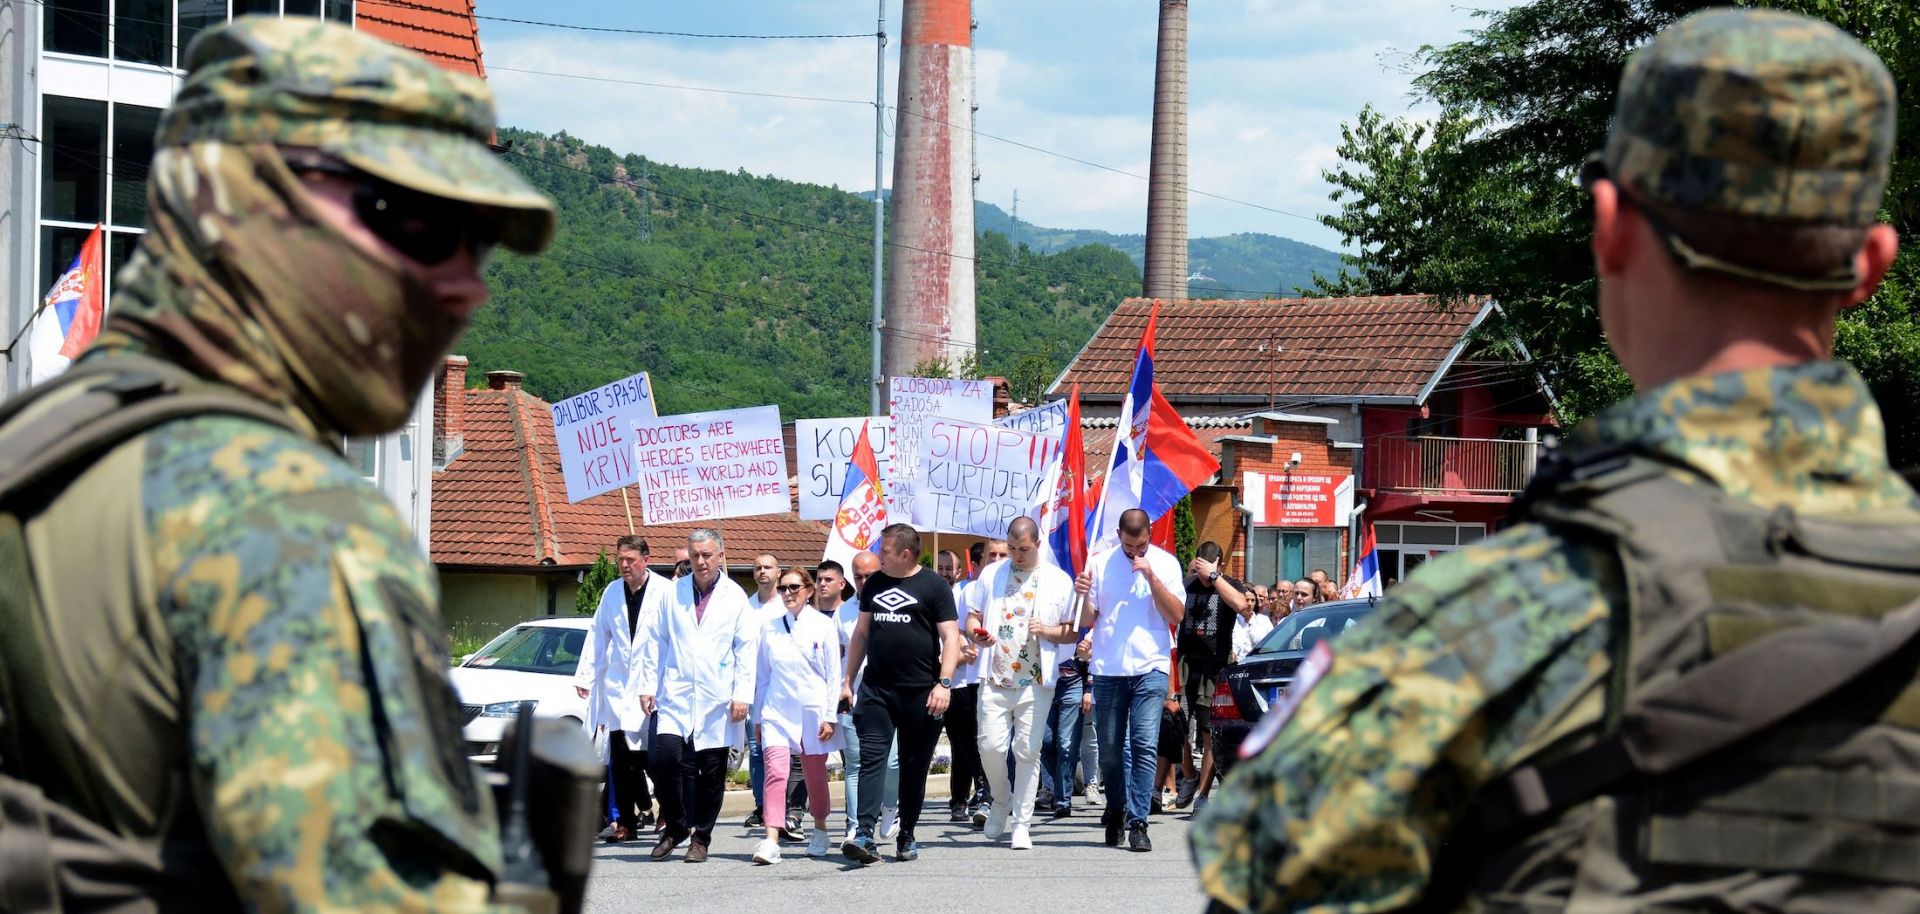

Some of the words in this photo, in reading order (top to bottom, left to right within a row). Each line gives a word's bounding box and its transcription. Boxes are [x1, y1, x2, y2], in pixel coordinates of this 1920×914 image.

[893, 378, 952, 396] SLOBODA
[553, 391, 602, 426] DALIBOR
[577, 415, 622, 454] NIJE
[636, 424, 700, 447] DOCTORS
[707, 421, 734, 437] ARE
[894, 438, 919, 454] NEM
[640, 447, 694, 468] HEROES
[700, 438, 782, 461] EVERYWHERE
[583, 444, 632, 490] KRIV
[696, 463, 745, 481] WORLD
[748, 460, 778, 478] AND
[648, 491, 669, 511] FOR
[673, 486, 724, 505] PRISTINA
[724, 483, 752, 499] THEY
[755, 482, 780, 496] ARE
[648, 500, 727, 523] CRIMINALS!!!
[873, 611, 912, 624] umbro
